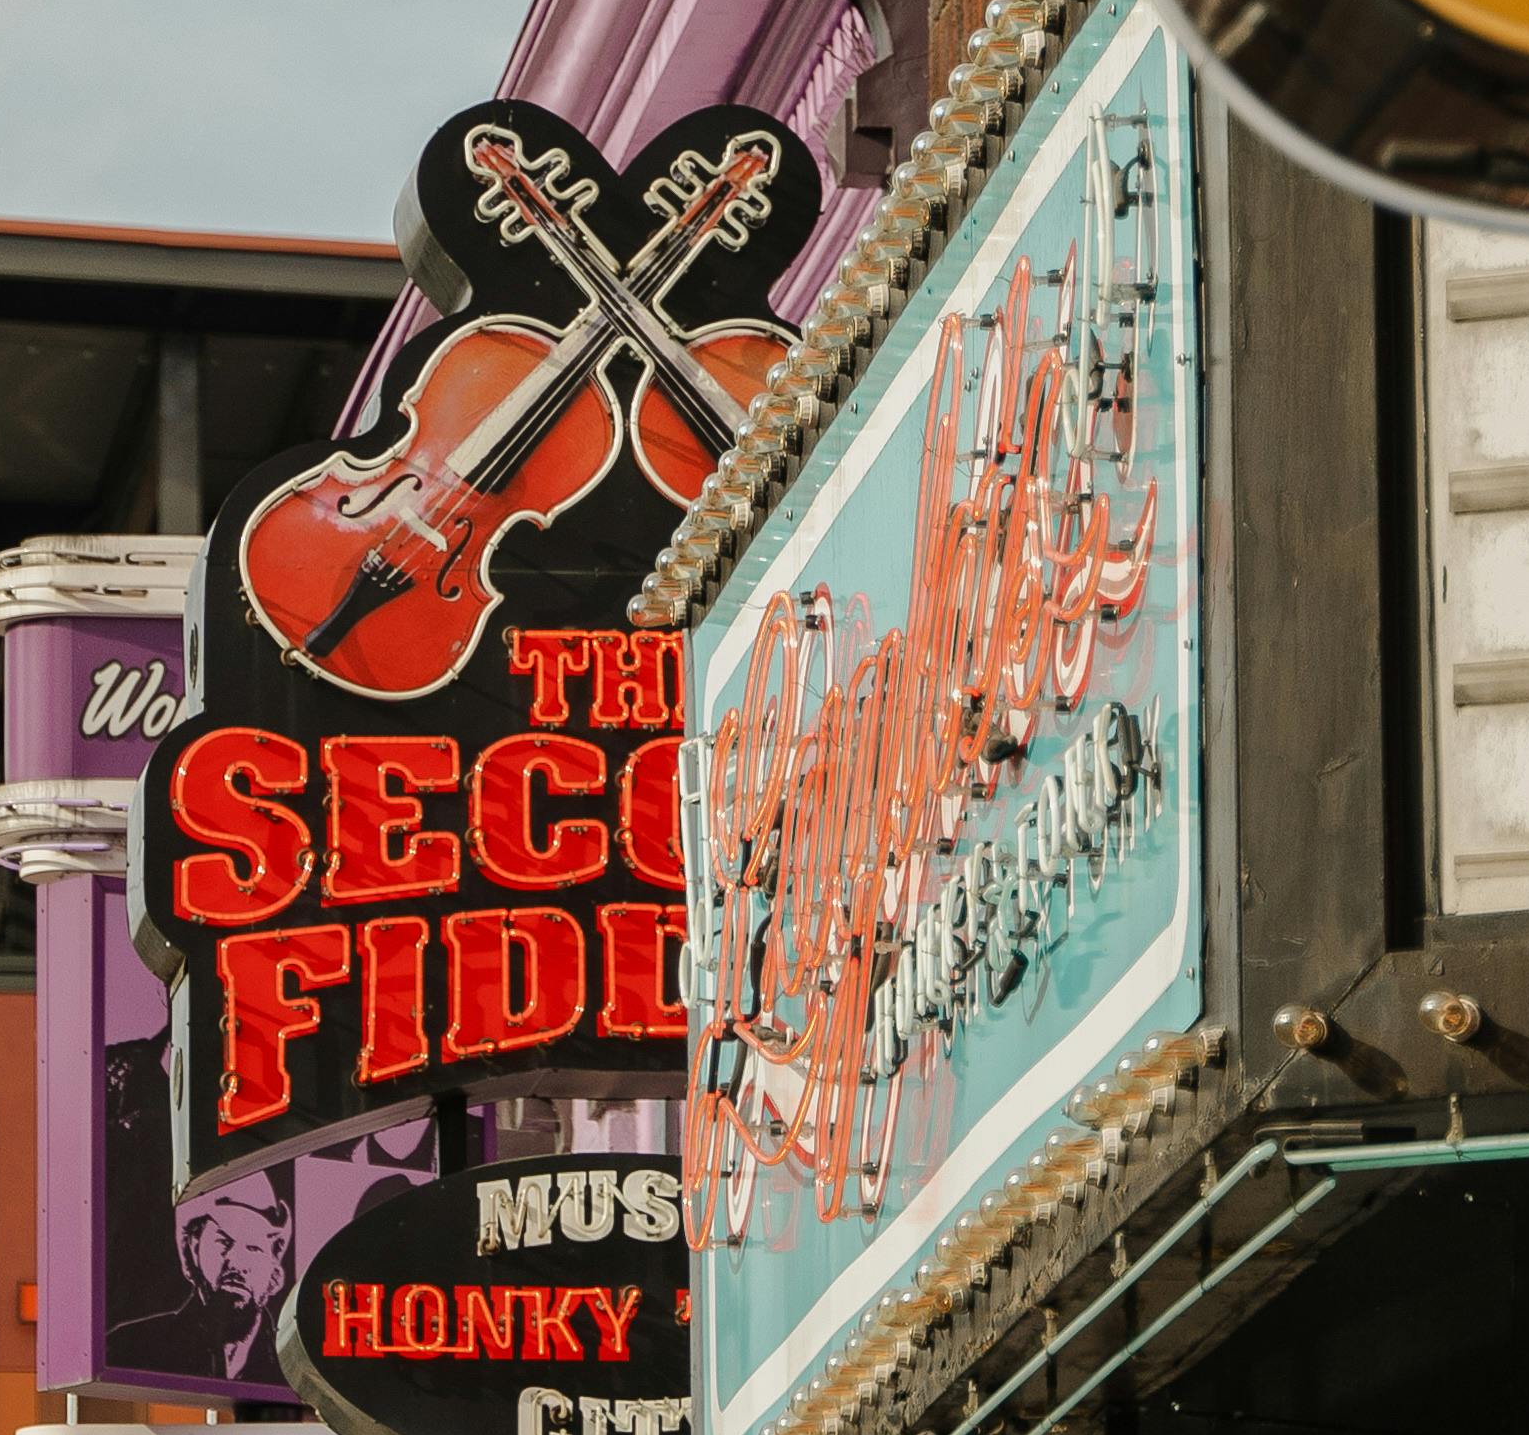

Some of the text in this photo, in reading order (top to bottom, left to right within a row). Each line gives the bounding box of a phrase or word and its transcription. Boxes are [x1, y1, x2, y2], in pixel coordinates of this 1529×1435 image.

[506, 628, 685, 729] TH
[476, 1169, 682, 1257] MUS
[322, 1282, 642, 1363] HONKY
